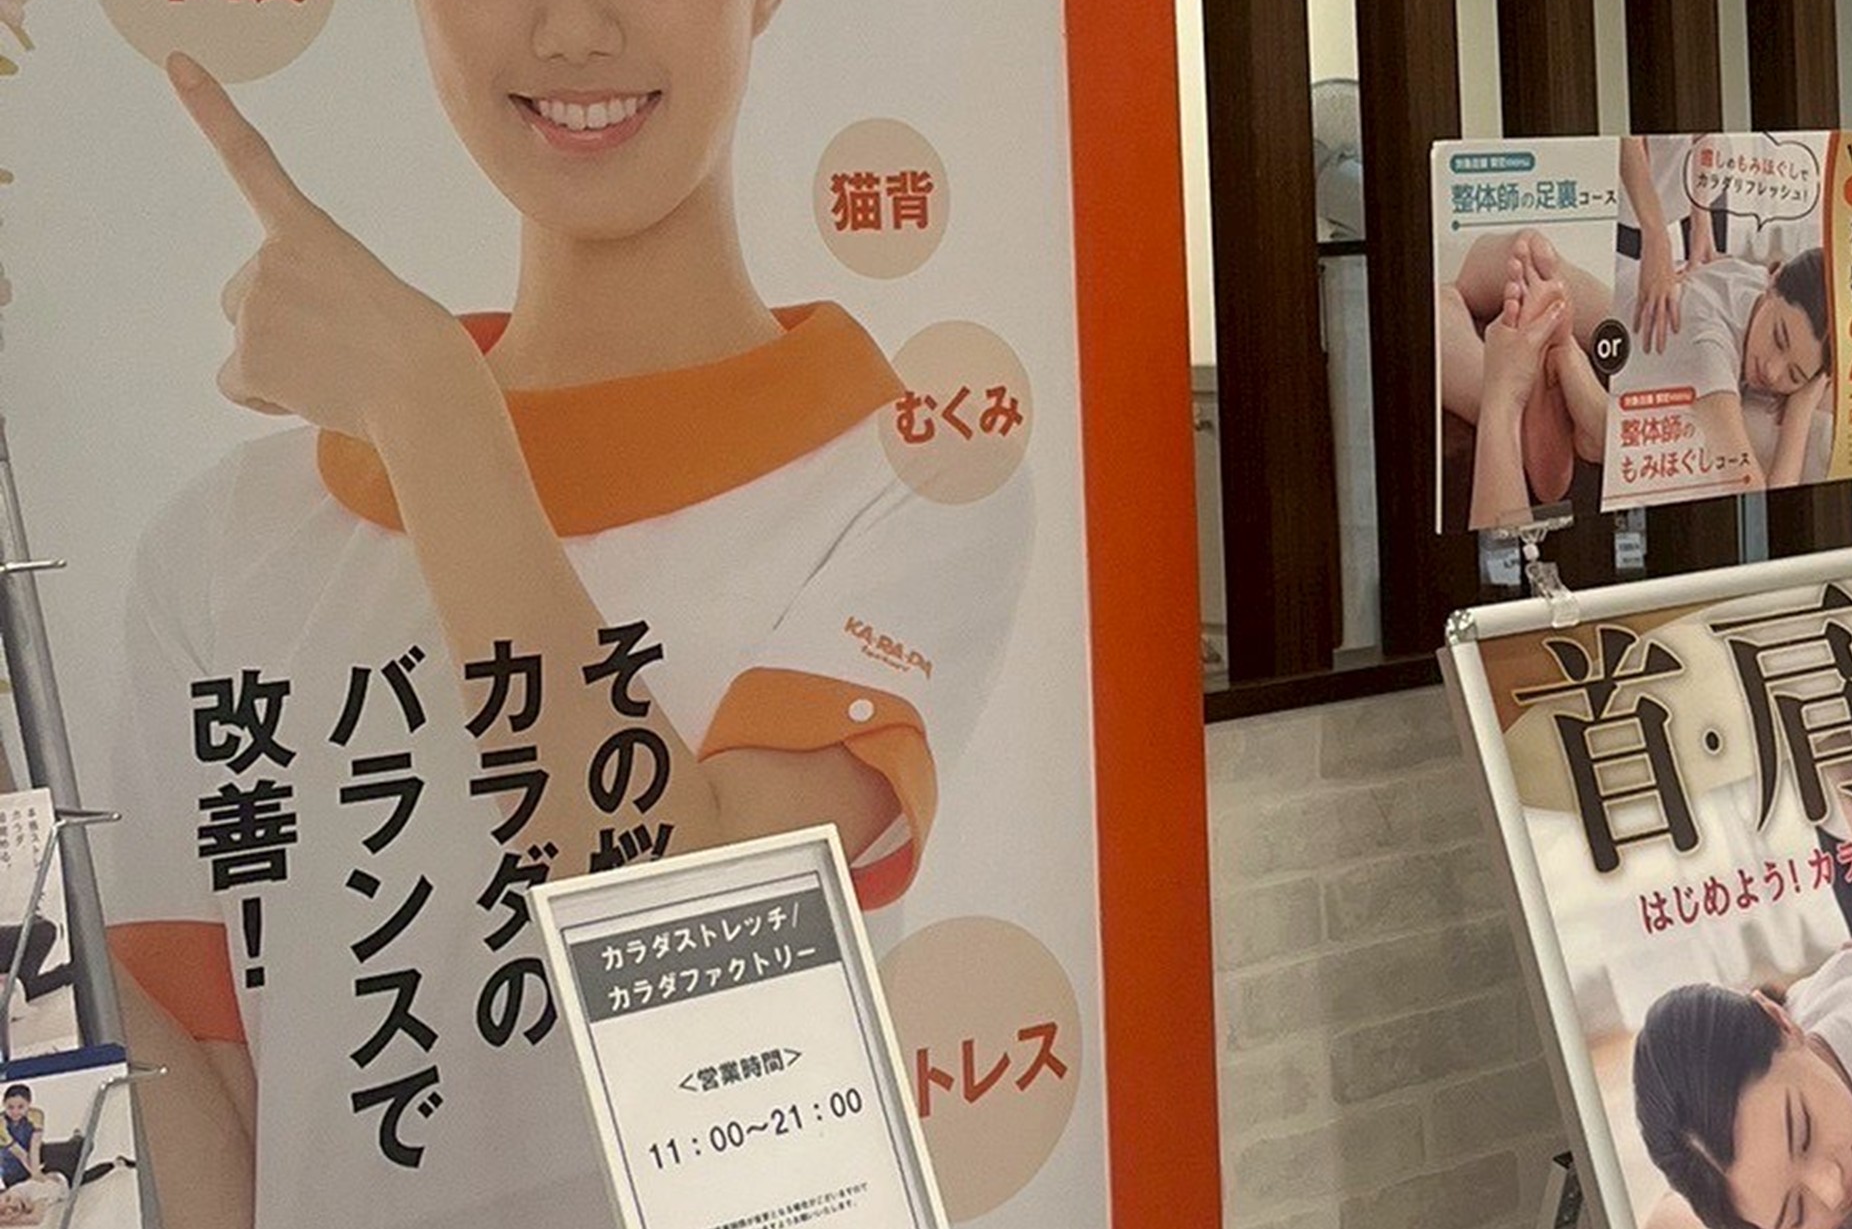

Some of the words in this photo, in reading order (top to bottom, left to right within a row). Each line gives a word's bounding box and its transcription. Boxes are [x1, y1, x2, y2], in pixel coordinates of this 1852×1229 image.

[830, 170, 934, 232] 猫背
[1452, 179, 1618, 214] 整体師の足裏コース
[1597, 337, 1622, 359] or
[895, 385, 1025, 445] むくみ
[1620, 414, 1696, 448] 整体師の
[1621, 447, 1751, 484] もみほぐしコース
[190, 669, 297, 989] 改善！
[464, 639, 558, 1048] カラダの
[329, 644, 444, 1169] バランスで
[607, 945, 817, 1012] カラダファクトリー
